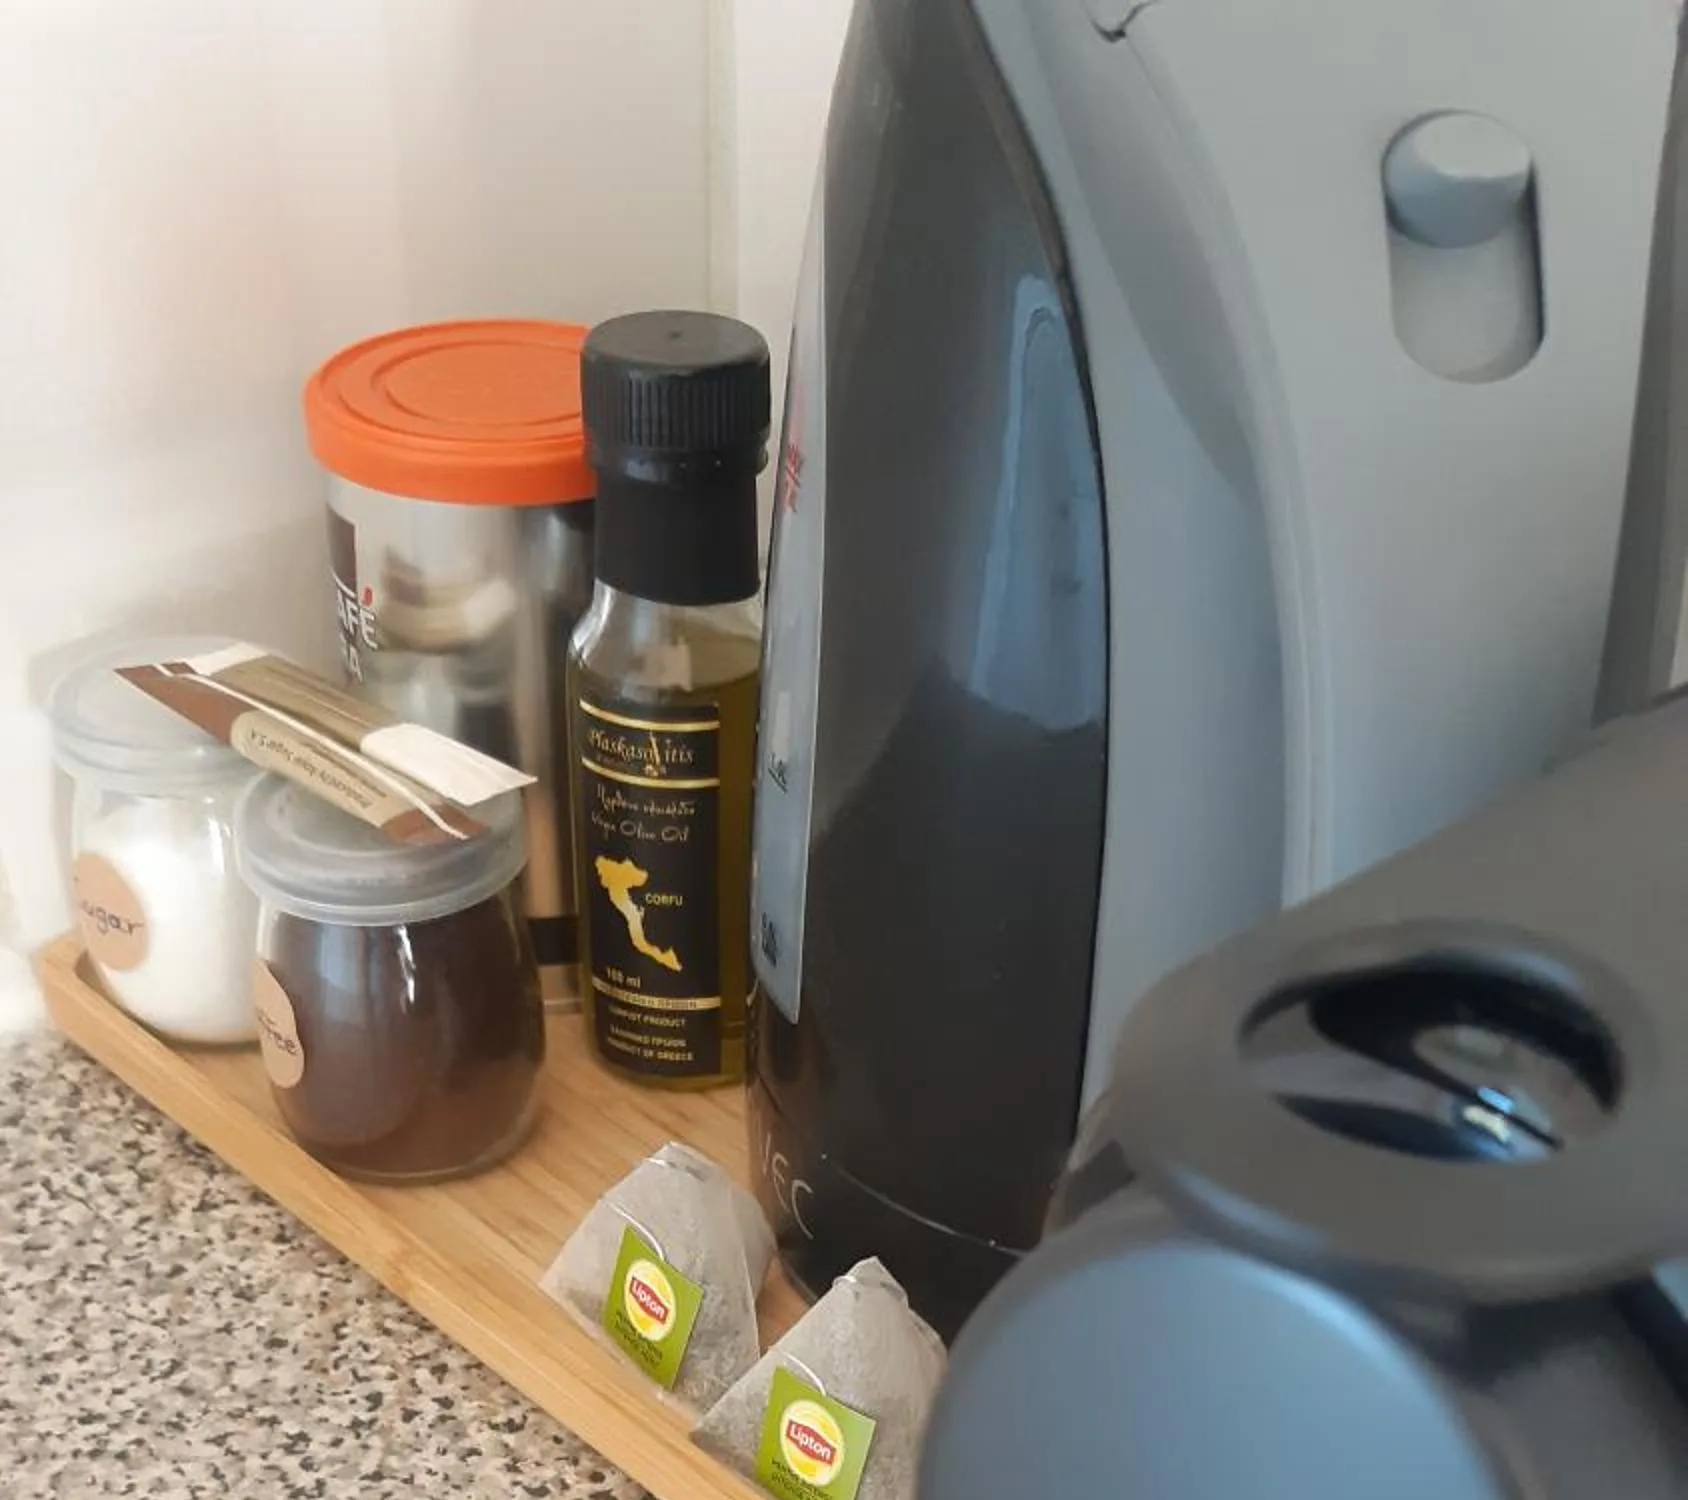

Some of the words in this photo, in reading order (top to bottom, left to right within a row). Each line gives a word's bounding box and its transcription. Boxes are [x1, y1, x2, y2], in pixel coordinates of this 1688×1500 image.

[619, 820, 656, 840] Olive
[660, 825, 690, 842] Oil
[644, 893, 684, 907] CORFU
[626, 975, 642, 989] ml
[631, 1279, 666, 1319] Lipton
[789, 1421, 832, 1460] Lipton
